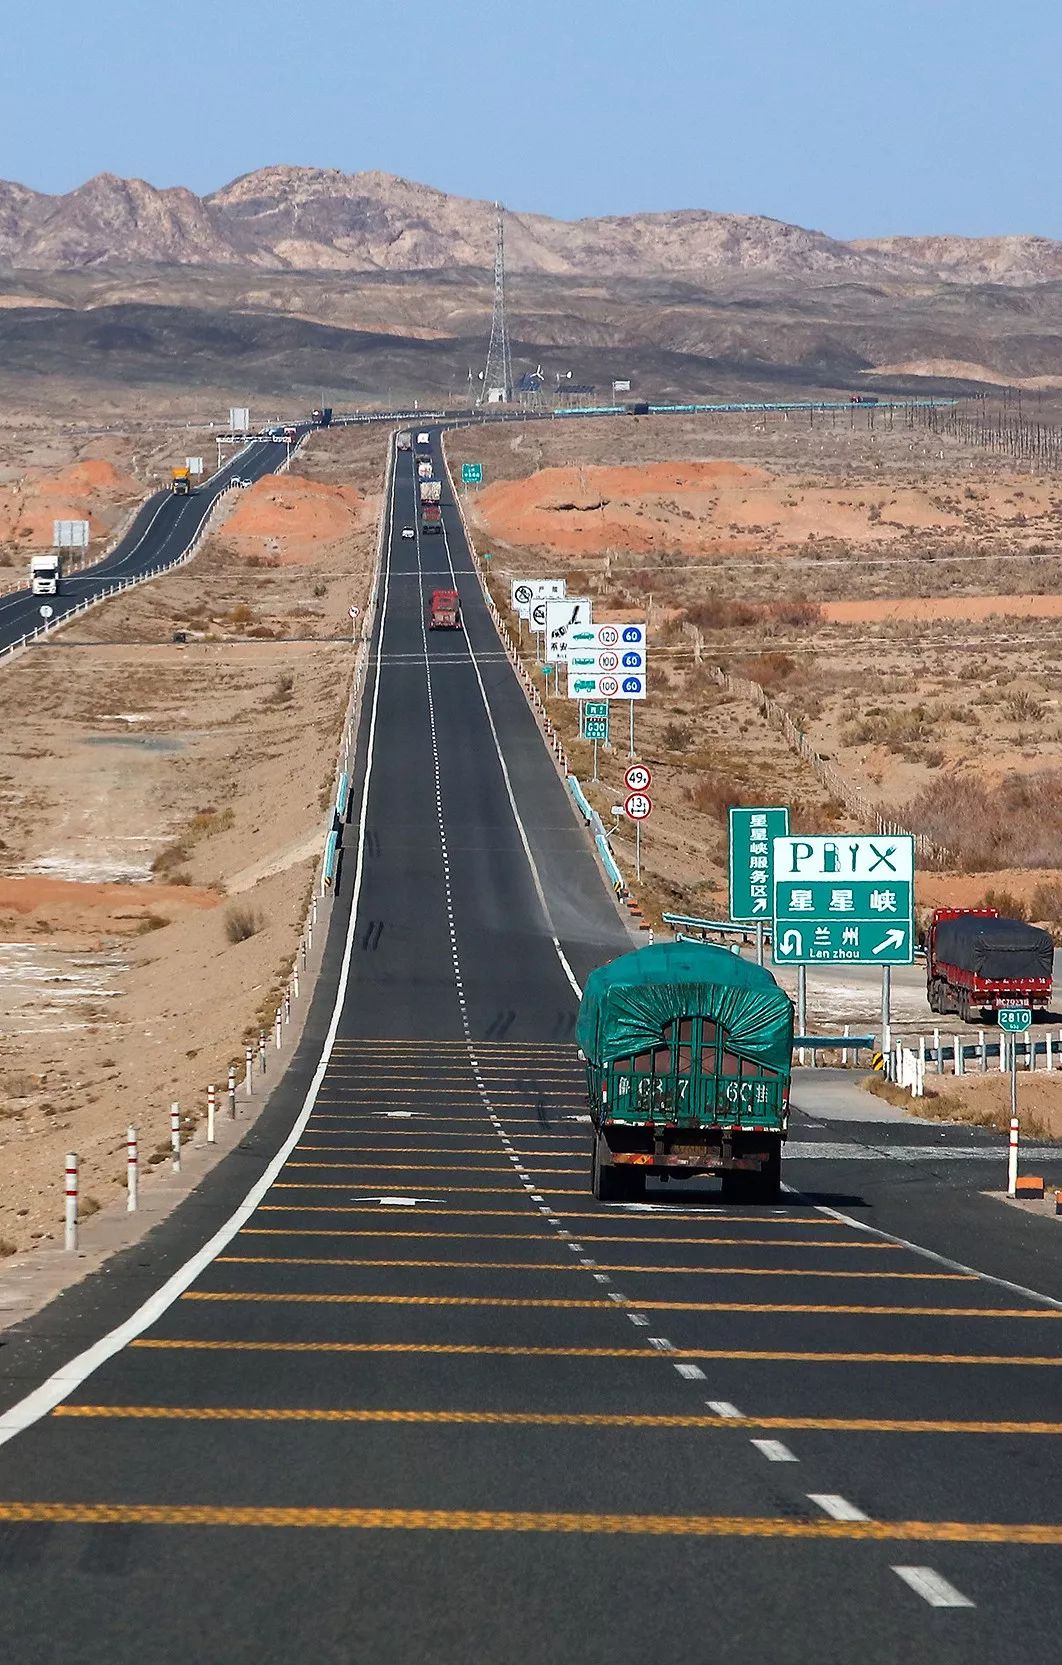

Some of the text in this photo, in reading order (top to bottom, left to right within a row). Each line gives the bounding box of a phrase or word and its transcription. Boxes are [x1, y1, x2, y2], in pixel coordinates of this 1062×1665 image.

[602, 631, 638, 642] 120 60
[602, 655, 638, 666] 100 60
[602, 681, 638, 691] 100 60
[588, 722, 605, 732] G30
[749, 814, 768, 897] 星星峡服务区
[788, 843, 814, 872] P
[788, 889, 897, 912] 星星峡
[813, 927, 859, 946] 兰州
[809, 949, 859, 958] Lan zhou
[1001, 1012, 1029, 1023] 2810
